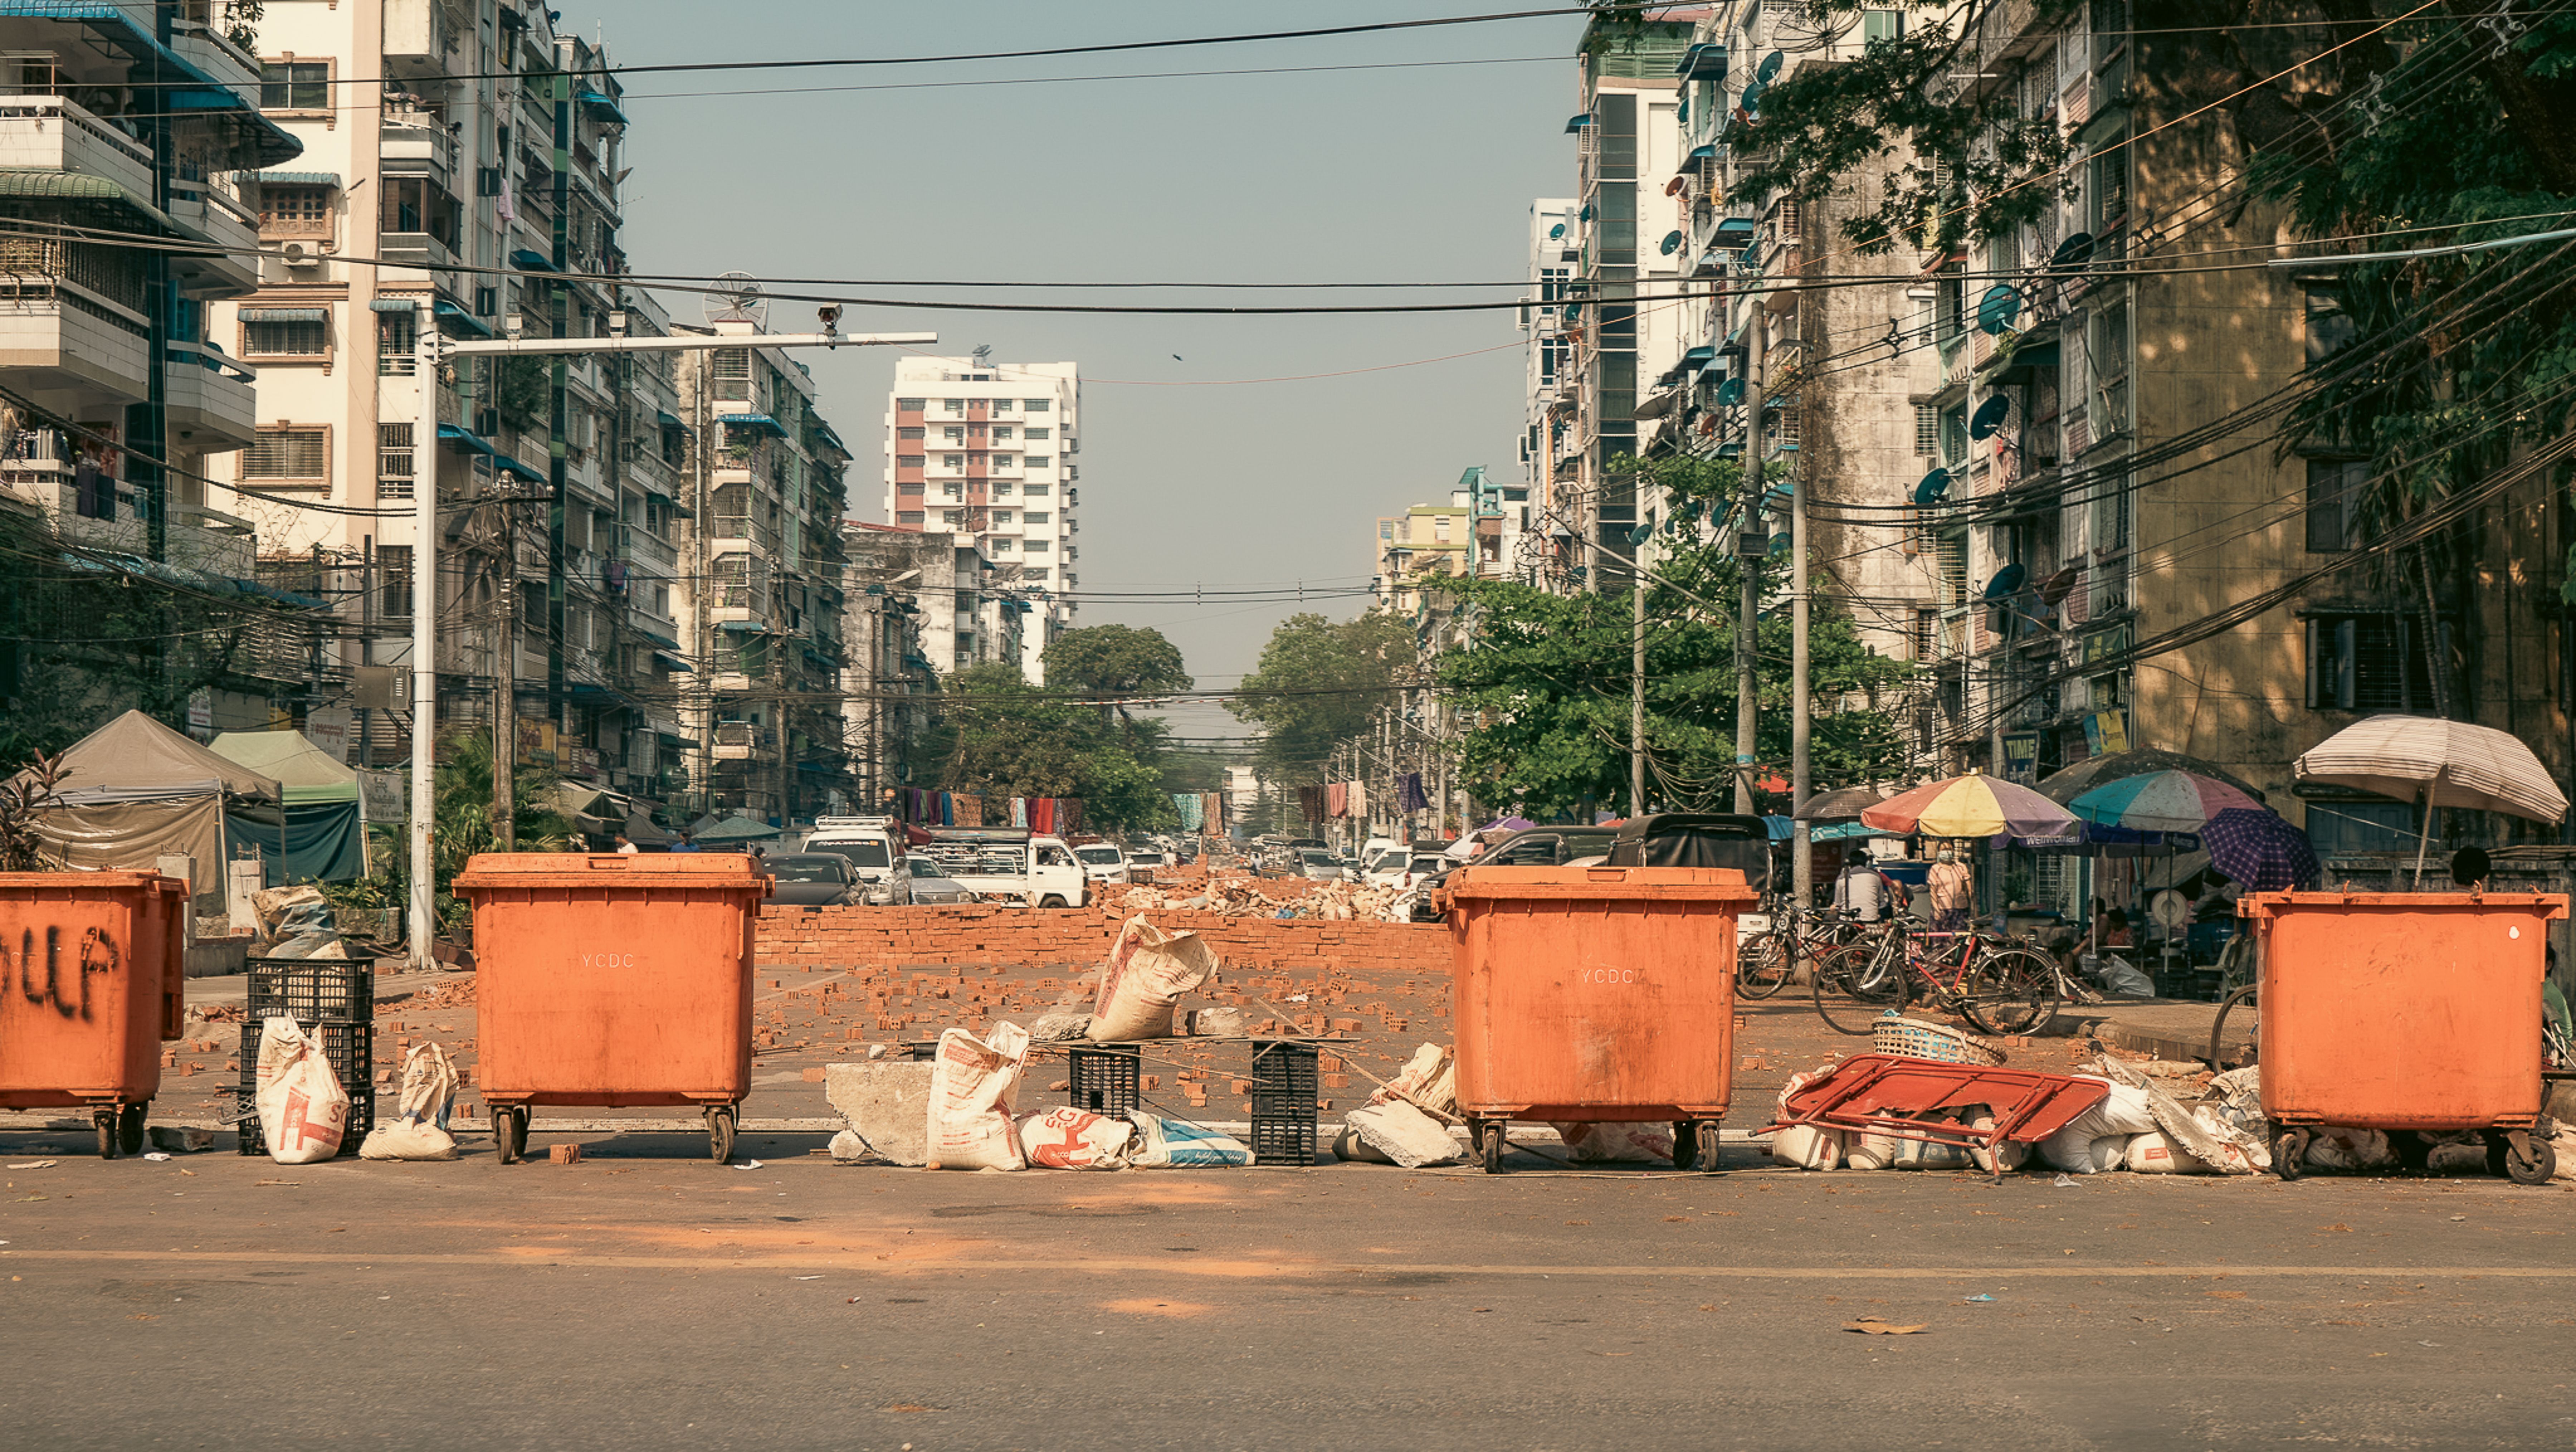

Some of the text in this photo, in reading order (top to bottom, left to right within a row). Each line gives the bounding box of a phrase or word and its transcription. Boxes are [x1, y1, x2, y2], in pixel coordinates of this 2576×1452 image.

[2006, 739, 2035, 759] TIME
[582, 953, 634, 968] YCDC
[1580, 969, 1633, 983] YCDC
